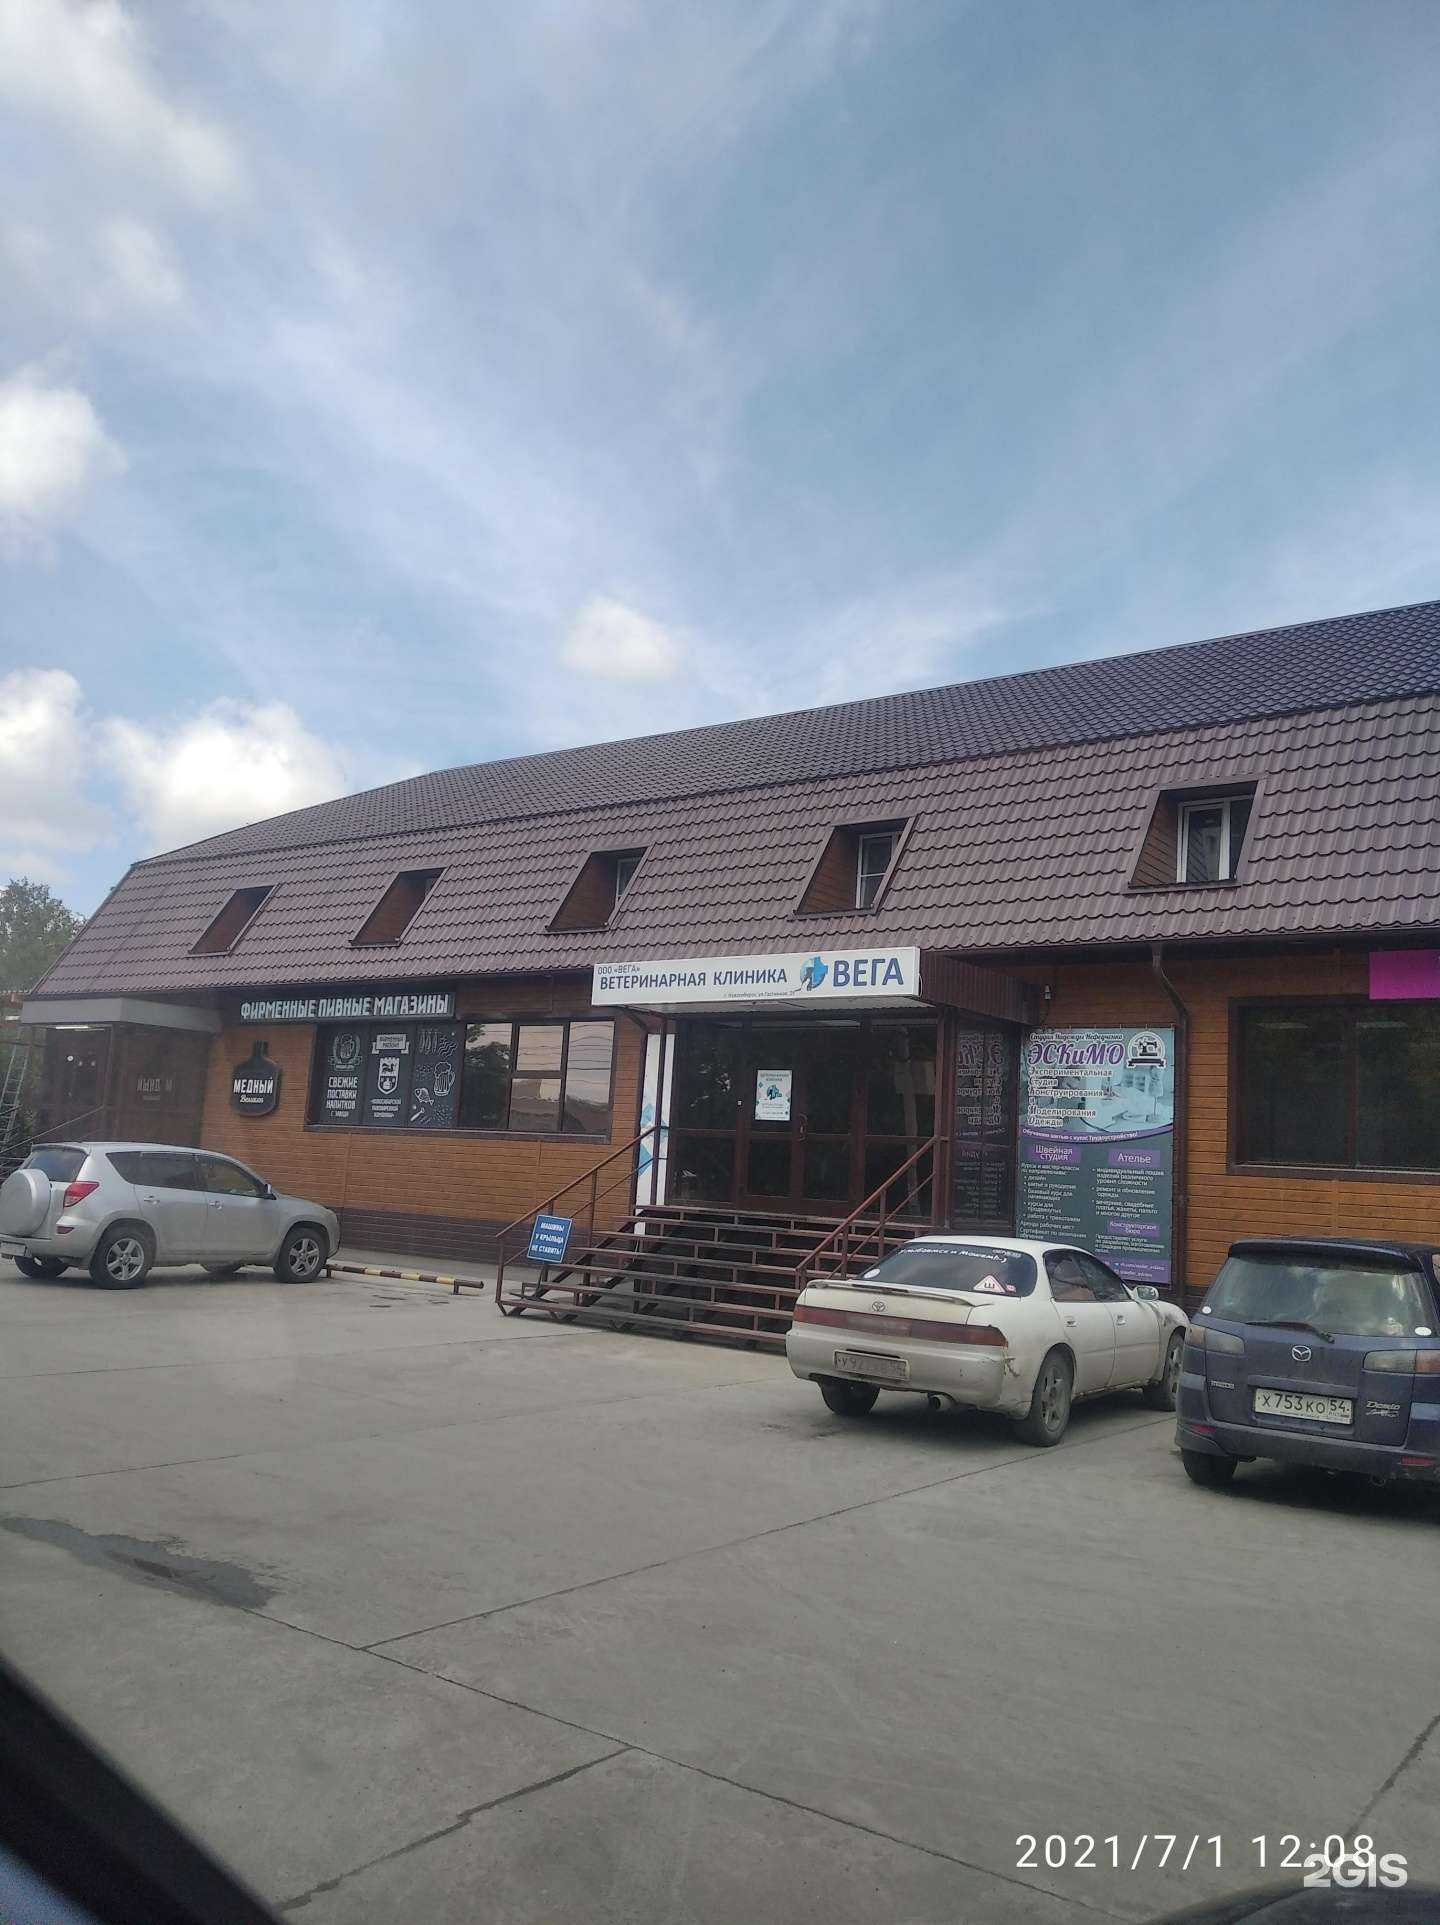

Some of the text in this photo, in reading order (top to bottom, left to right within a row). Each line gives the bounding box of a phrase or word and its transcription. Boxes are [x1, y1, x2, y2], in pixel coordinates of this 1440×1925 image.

[597, 965, 640, 975] ООО «ВЕГА»
[832, 957, 904, 988] ВЕГА
[600, 968, 788, 990] ВЕТЕРИНАРНАЯ КЛИНИКА
[241, 995, 448, 1019] ФИРМЕННЫЕ ПИВНЫЕ МАГАЗИНЫ
[1028, 1042, 1125, 1066] ЭСКиМО
[1028, 1067, 1113, 1078] Экспериментальная
[233, 1076, 274, 1094] МЕДНЫЙ
[328, 1076, 359, 1088] СВЕЖИЕ
[1028, 1078, 1058, 1088] Студия
[326, 1089, 358, 1100] ПОСТАВКИ
[1029, 1088, 1104, 1099] Конструирования
[326, 1099, 356, 1110] НАПИТКОВ
[1028, 1105, 1097, 1117] Моделирования
[1028, 1117, 1064, 1127] Одежды
[1035, 1144, 1074, 1156] Швейная
[1039, 1153, 1069, 1162] студия
[1117, 1152, 1152, 1165] Ателье
[541, 1222, 565, 1231] МАШИНЫ
[540, 1234, 564, 1244] КРЫЛЬЦА
[1329, 1399, 1346, 1413] 54
